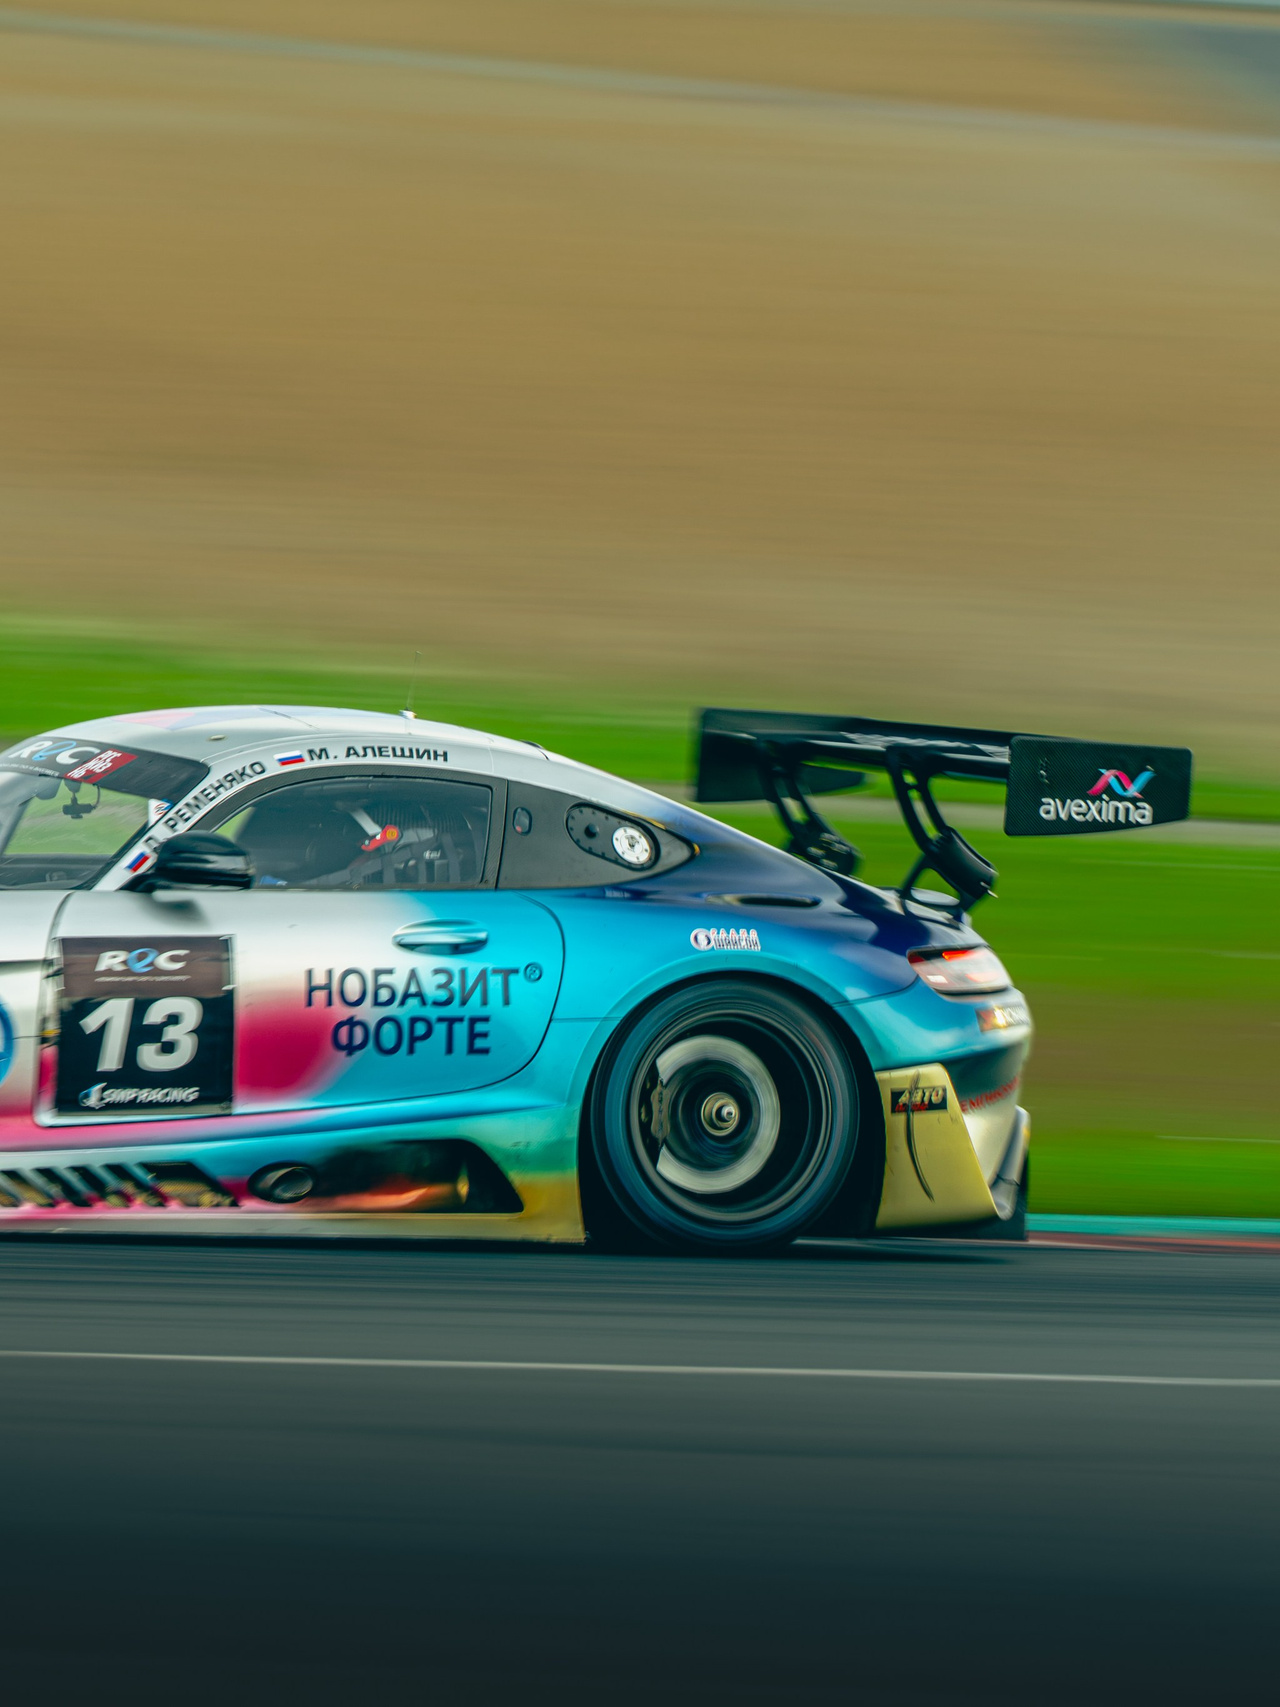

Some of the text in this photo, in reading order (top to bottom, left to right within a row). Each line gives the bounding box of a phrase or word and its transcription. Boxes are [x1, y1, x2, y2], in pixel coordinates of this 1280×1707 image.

[345, 746, 448, 763] АЛЕШИН
[162, 761, 266, 834] РЕМЕНЯКО
[1039, 794, 1153, 824] avexima
[79, 996, 204, 1072] 13
[331, 1015, 492, 1057] ФОРТЕ
[135, 1087, 200, 1103] RACING
